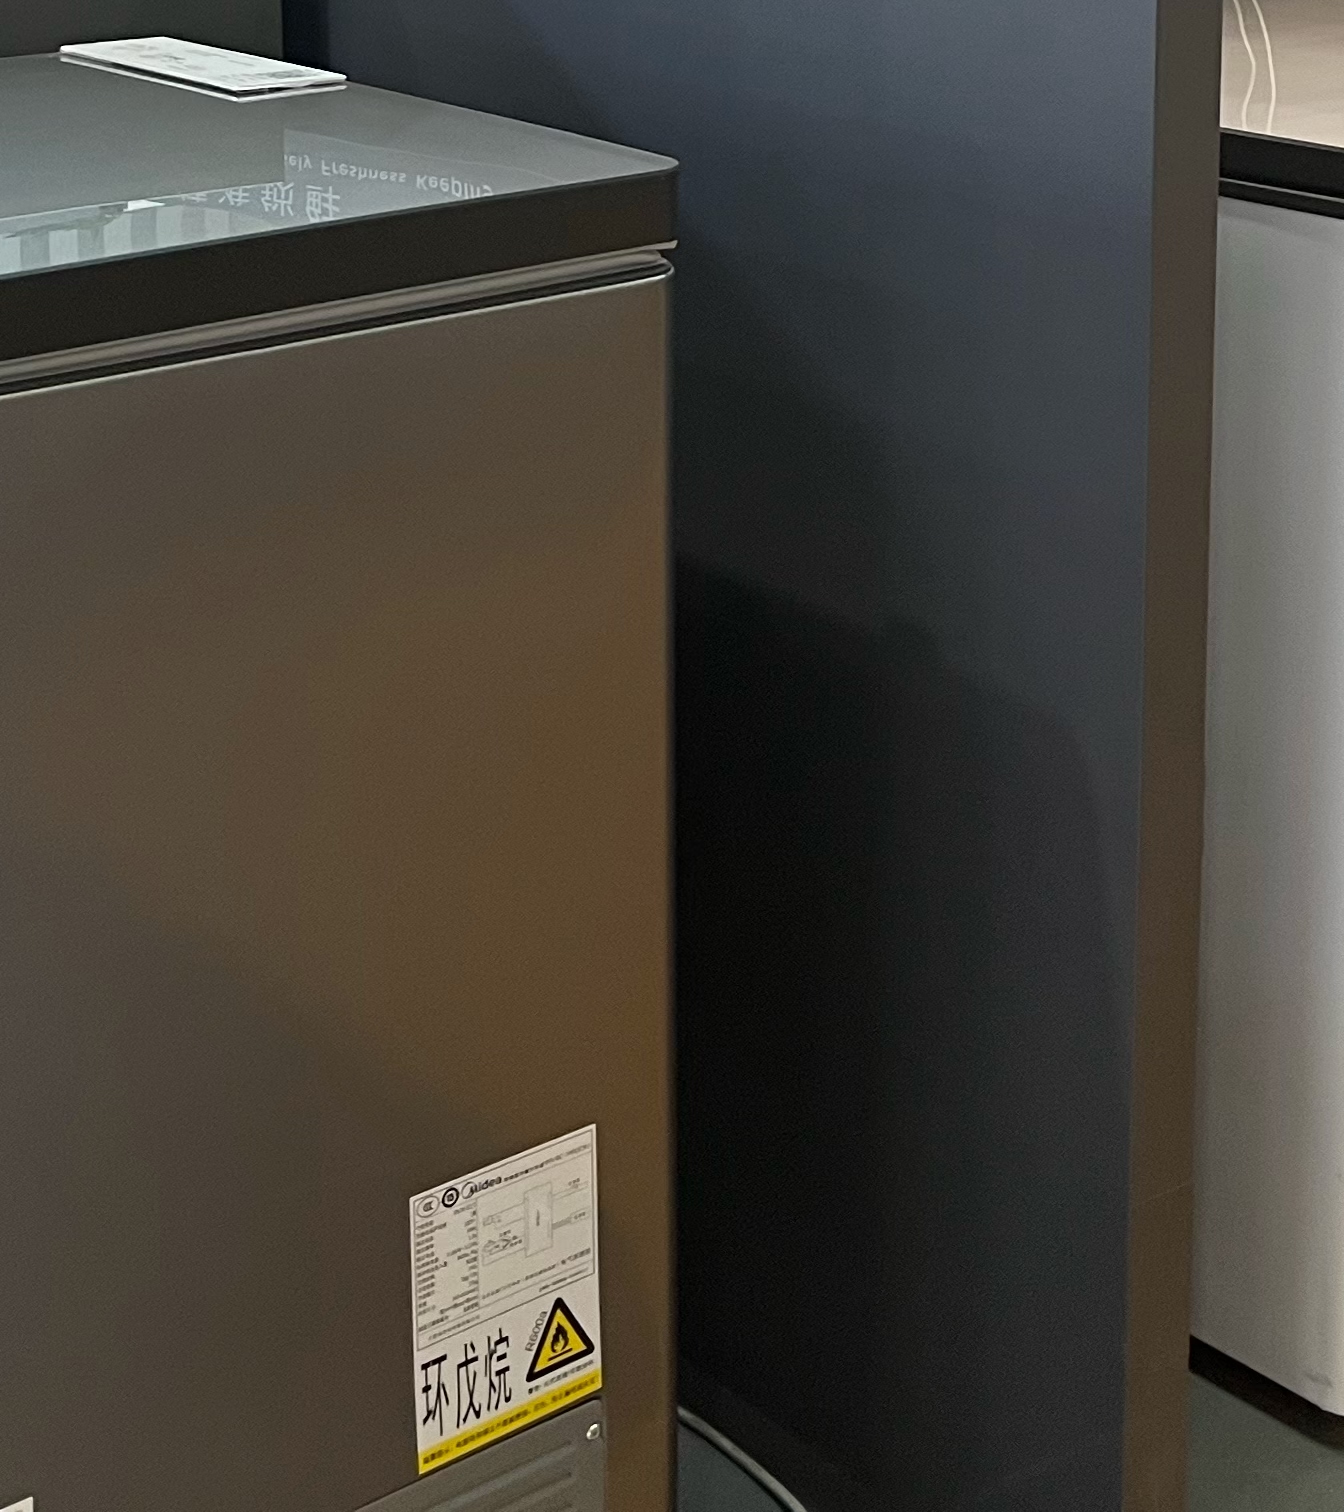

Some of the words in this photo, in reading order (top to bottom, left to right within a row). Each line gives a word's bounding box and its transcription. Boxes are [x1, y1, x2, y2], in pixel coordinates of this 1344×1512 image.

[461, 1176, 503, 1199] Midea
[524, 1310, 549, 1354] R600a
[421, 1327, 513, 1437] 环戊烷
